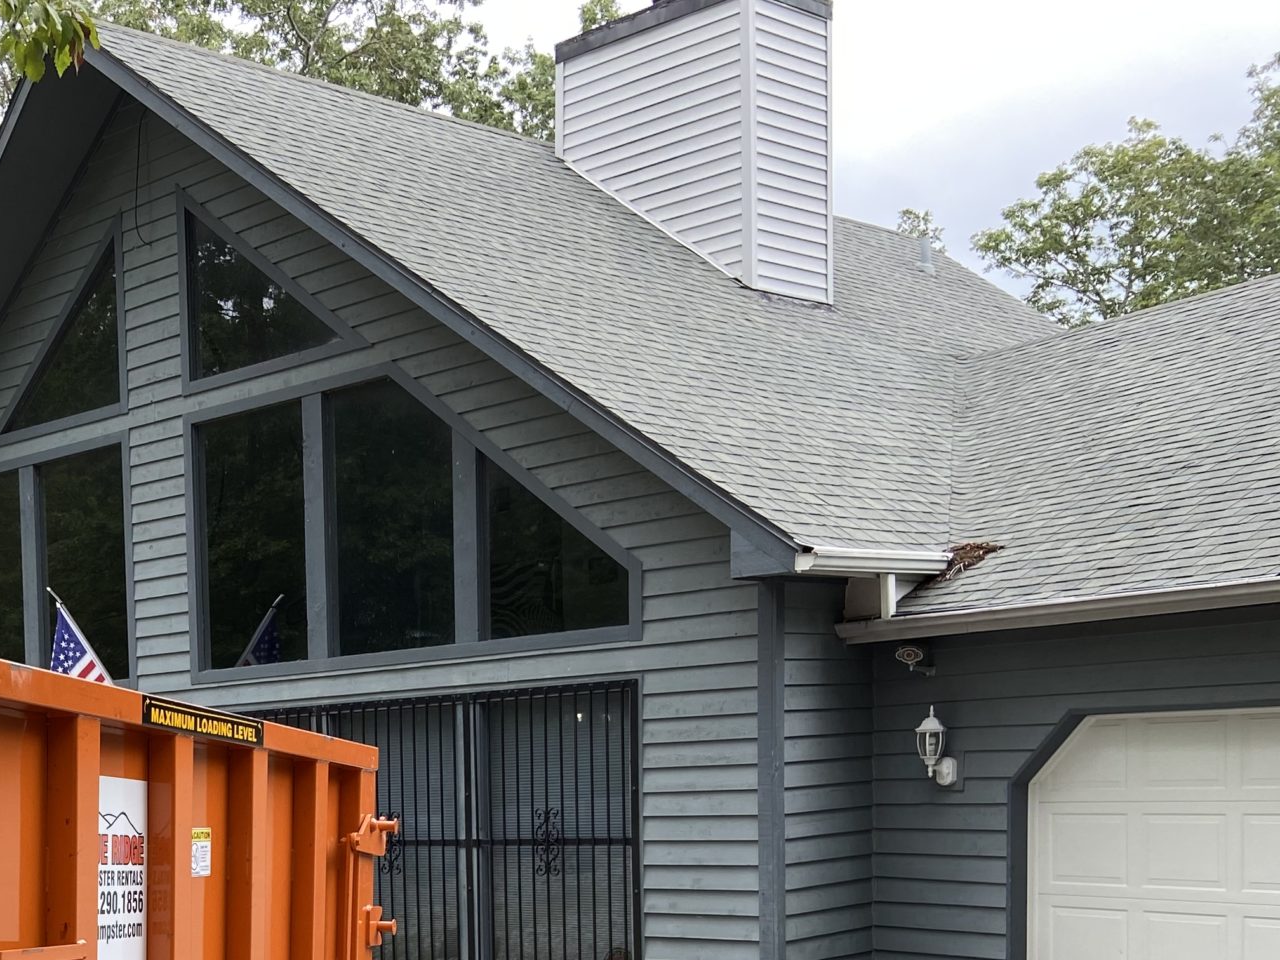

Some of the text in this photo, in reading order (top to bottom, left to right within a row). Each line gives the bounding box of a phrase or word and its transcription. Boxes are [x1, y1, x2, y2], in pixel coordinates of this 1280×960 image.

[151, 707, 257, 742] MAXIMUM LOADING LEVEL
[111, 834, 145, 866] RIDGE
[116, 870, 144, 886] RENTALS
